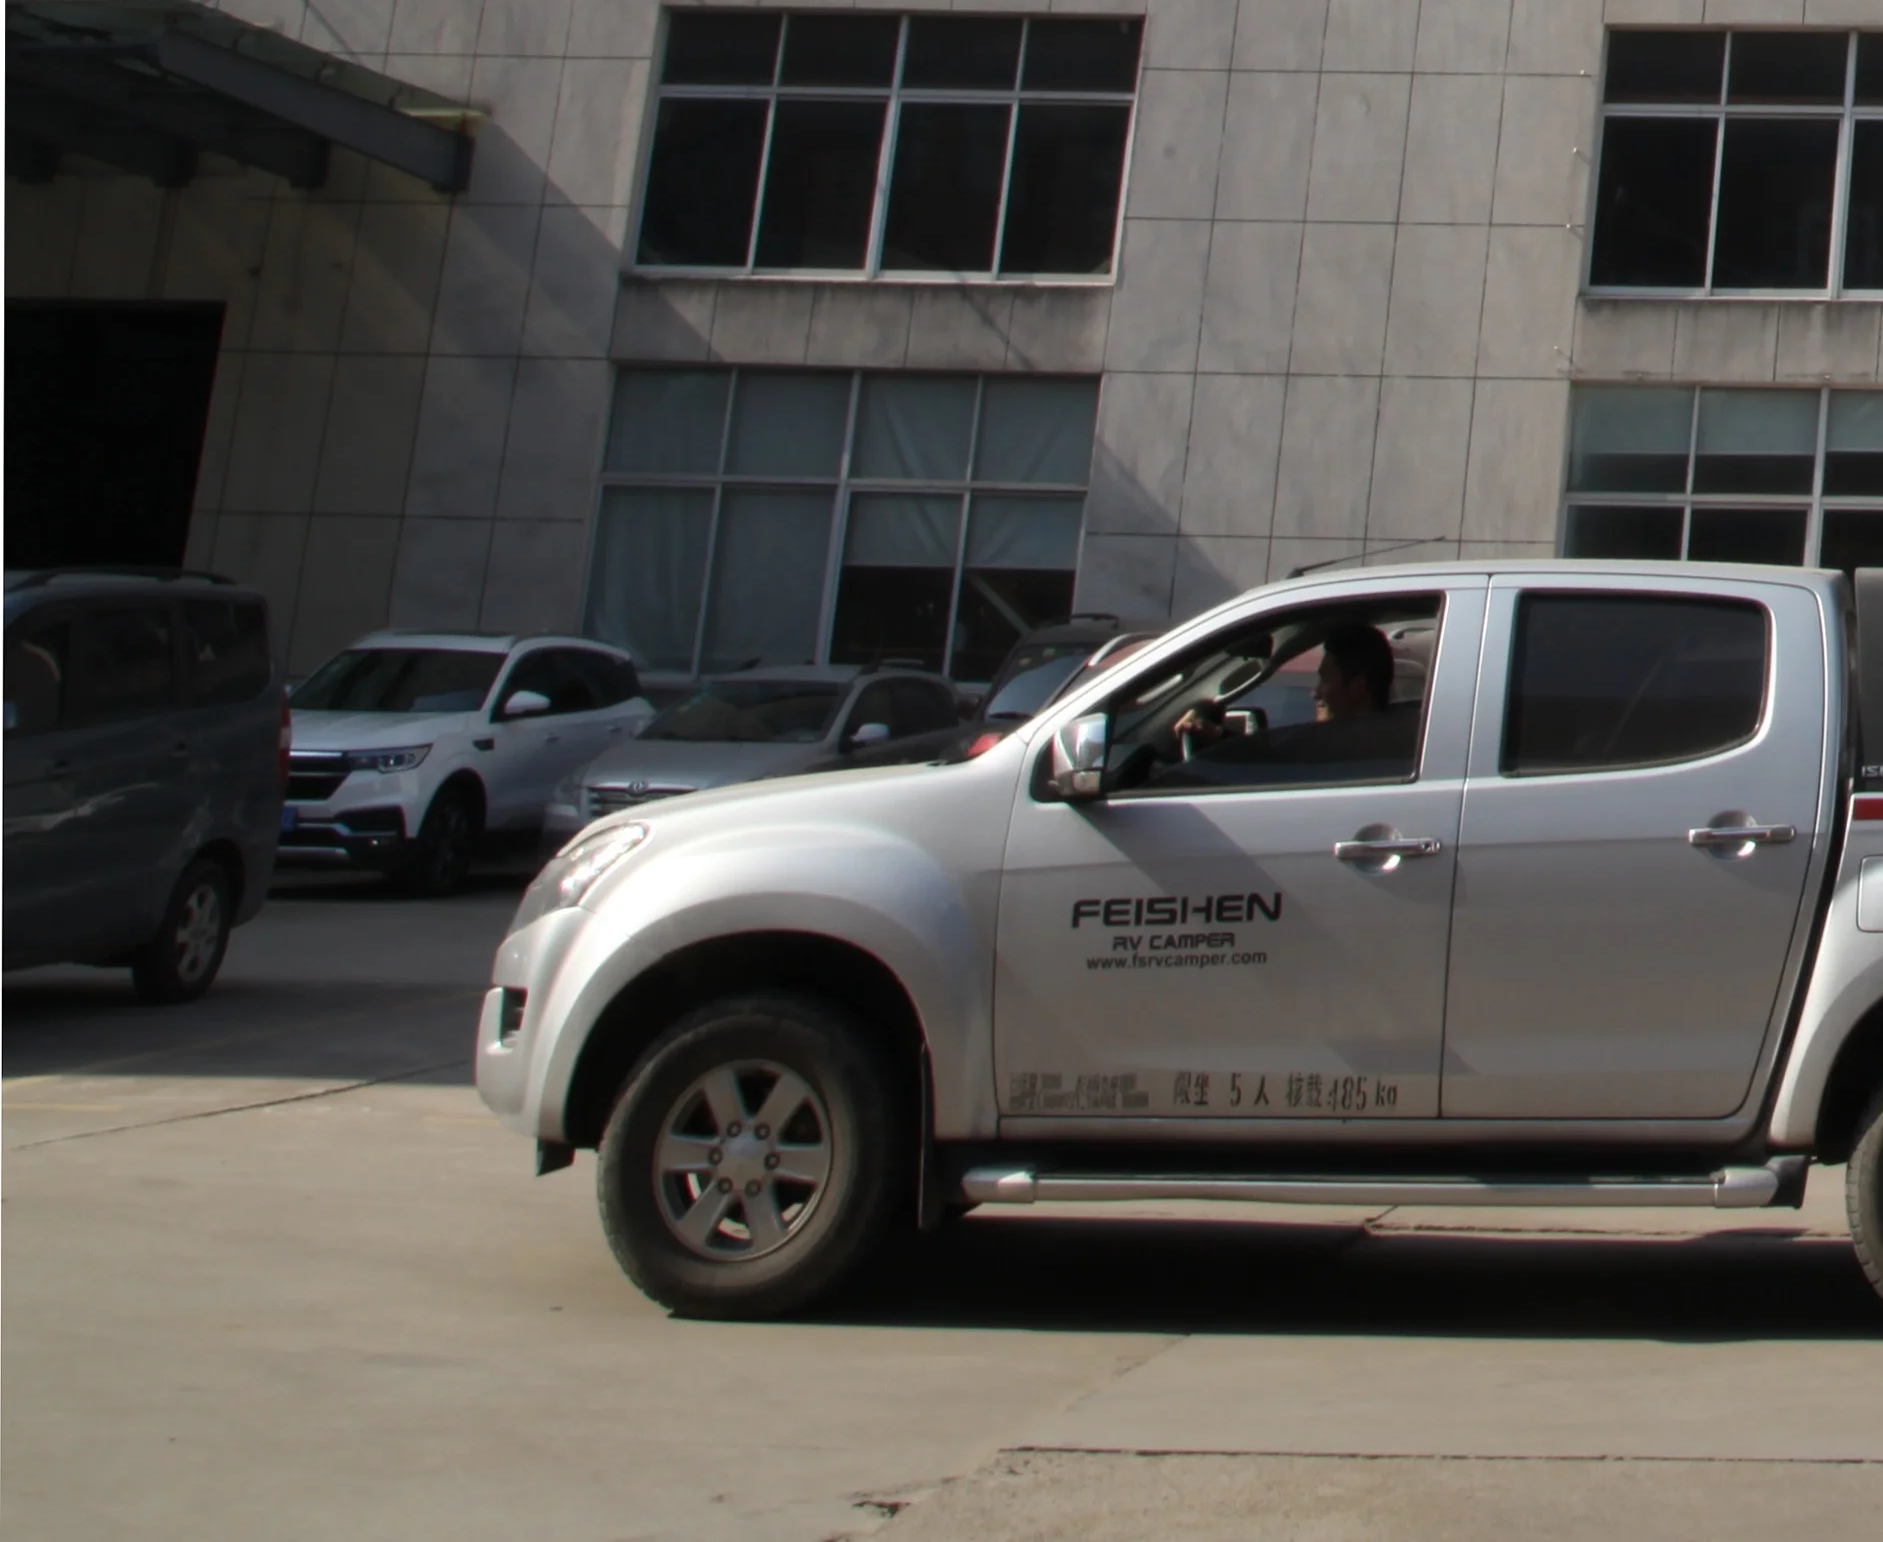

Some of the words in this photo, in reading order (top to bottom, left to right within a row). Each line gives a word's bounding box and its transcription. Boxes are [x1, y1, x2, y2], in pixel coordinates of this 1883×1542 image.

[1071, 892, 1283, 929] FEISHEN
[1112, 935, 1143, 951] RV
[1149, 932, 1236, 951] CAMPER
[1086, 951, 1268, 970] www.fsrvcamper.com
